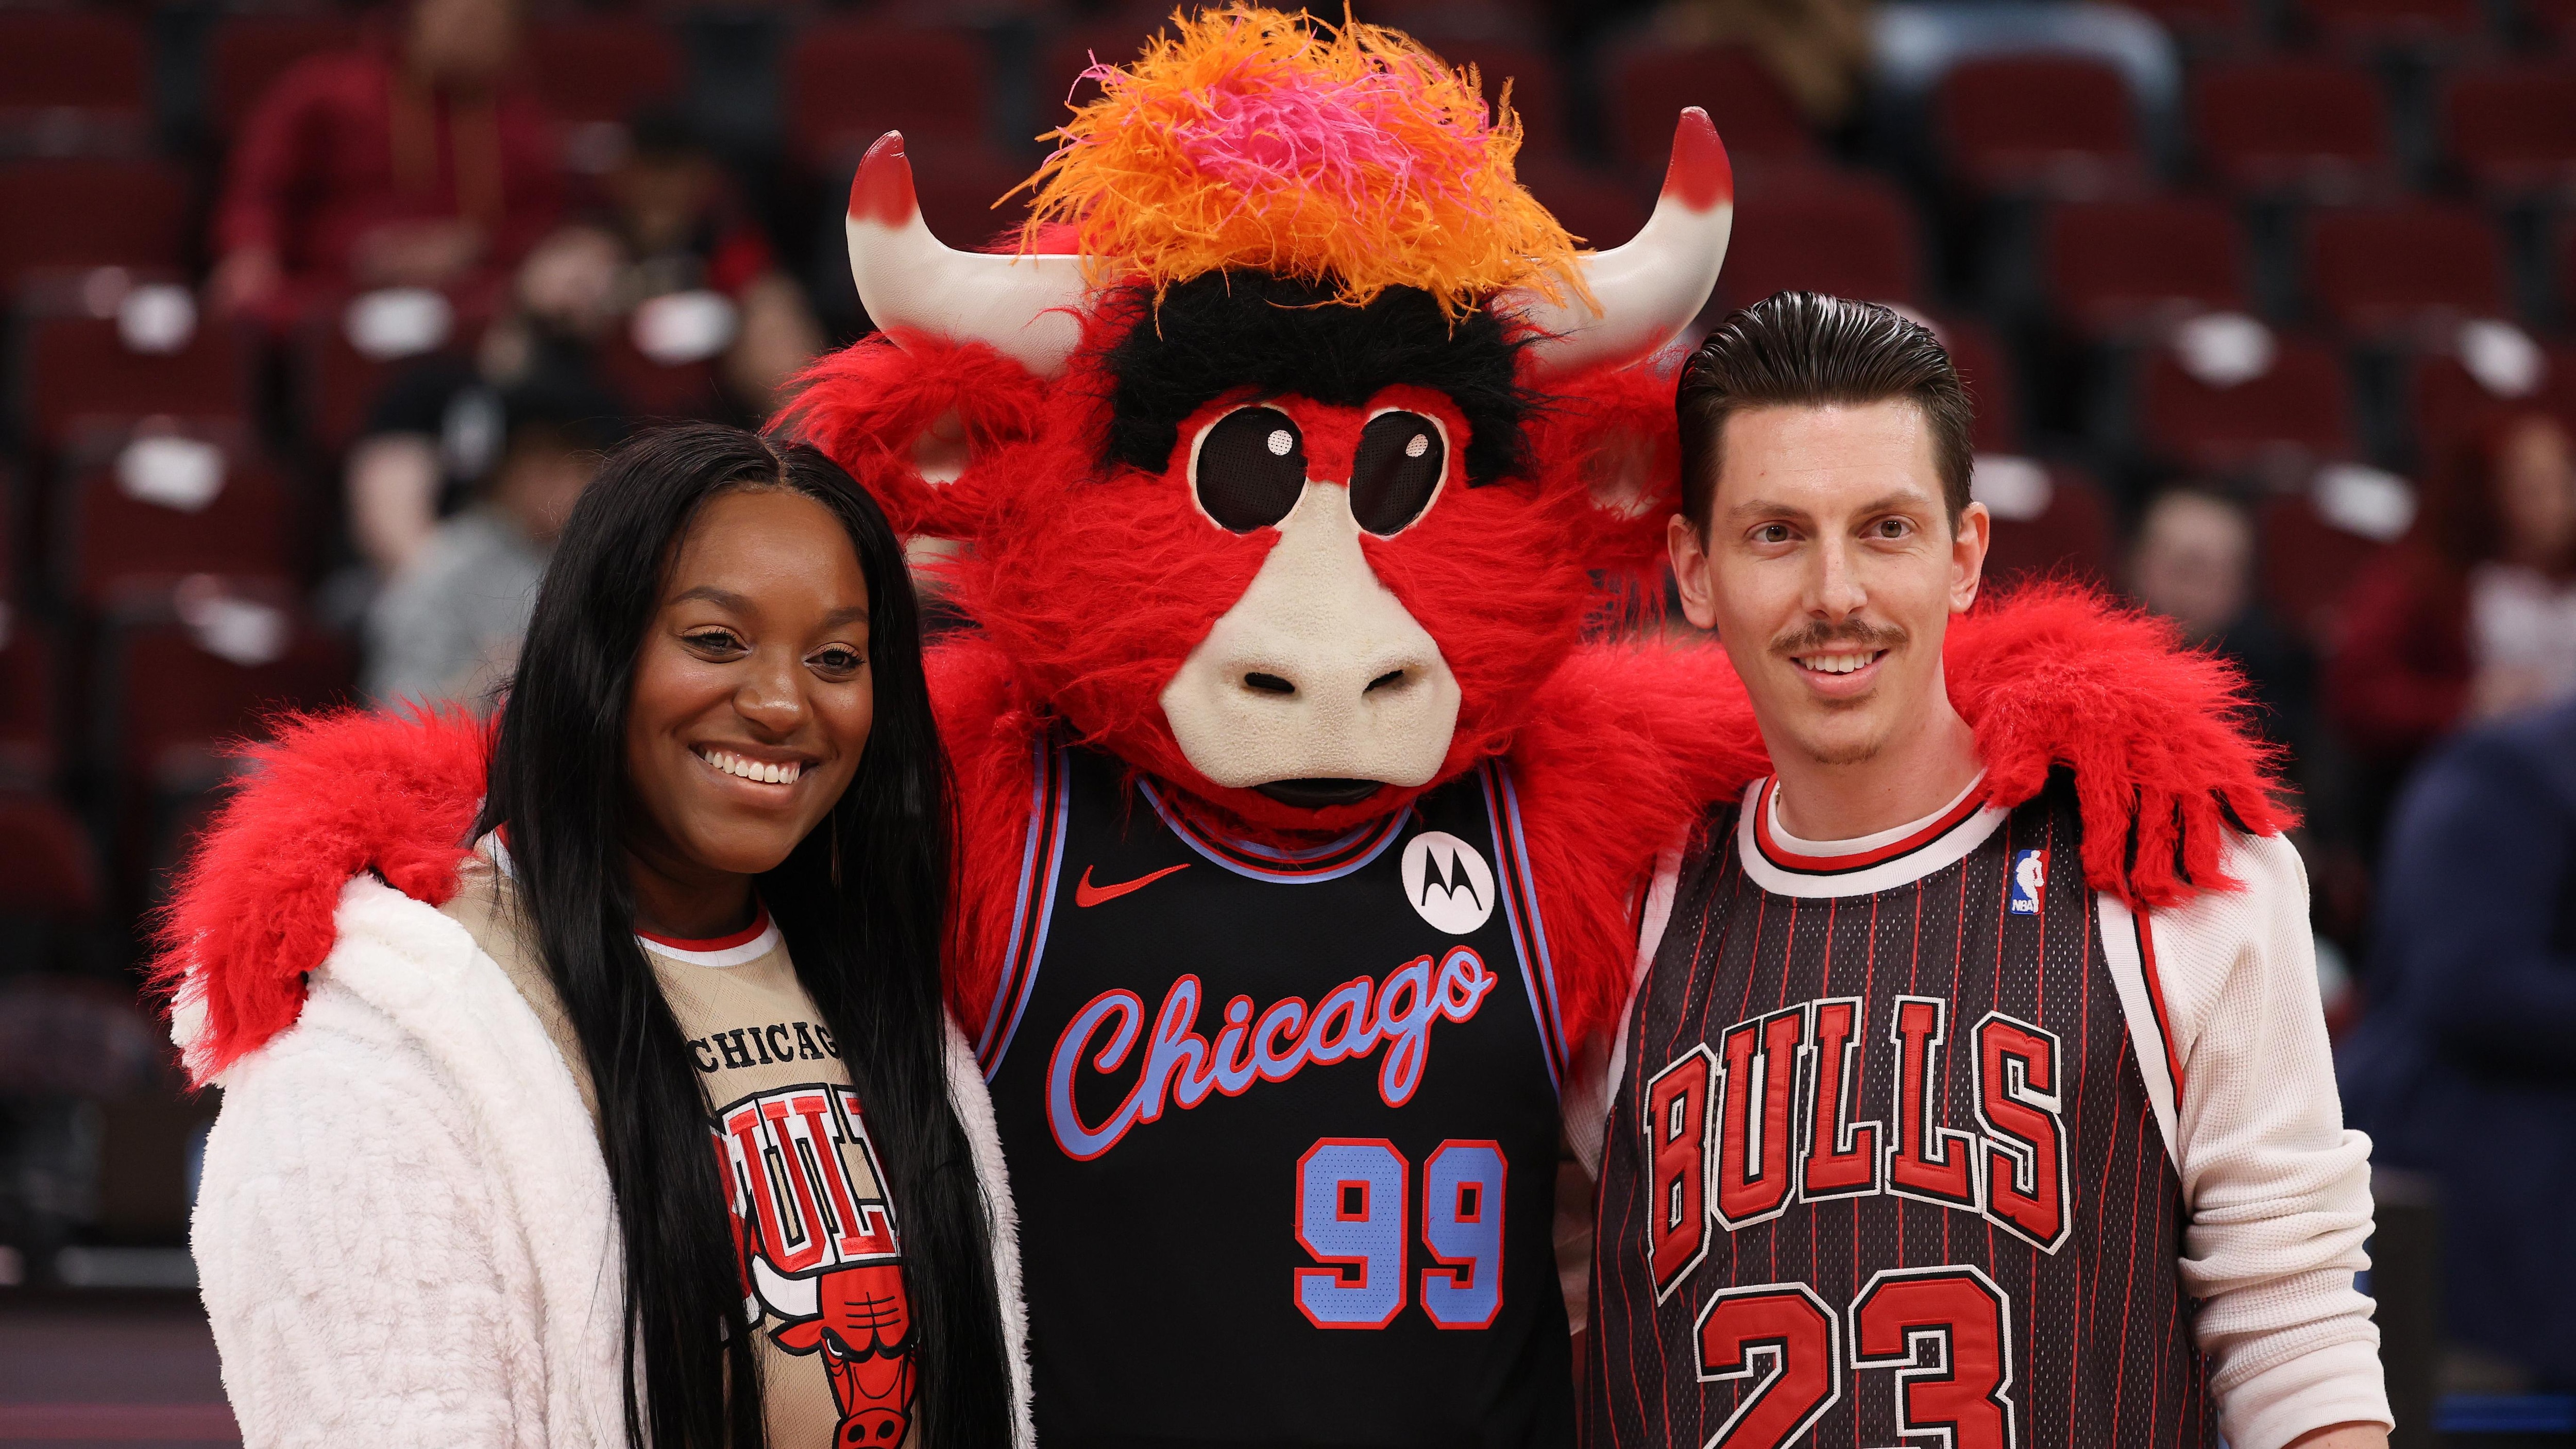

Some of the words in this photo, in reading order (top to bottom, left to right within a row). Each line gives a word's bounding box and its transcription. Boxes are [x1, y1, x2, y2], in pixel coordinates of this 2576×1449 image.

[2012, 899, 2033, 912] NBA
[685, 1021, 842, 1073] CHICAG
[1045, 945, 1498, 1161] Chicago
[1294, 1137, 1509, 1329] 99
[1643, 995, 2071, 1307] BULLS
[1693, 1264, 2016, 1449] 23
